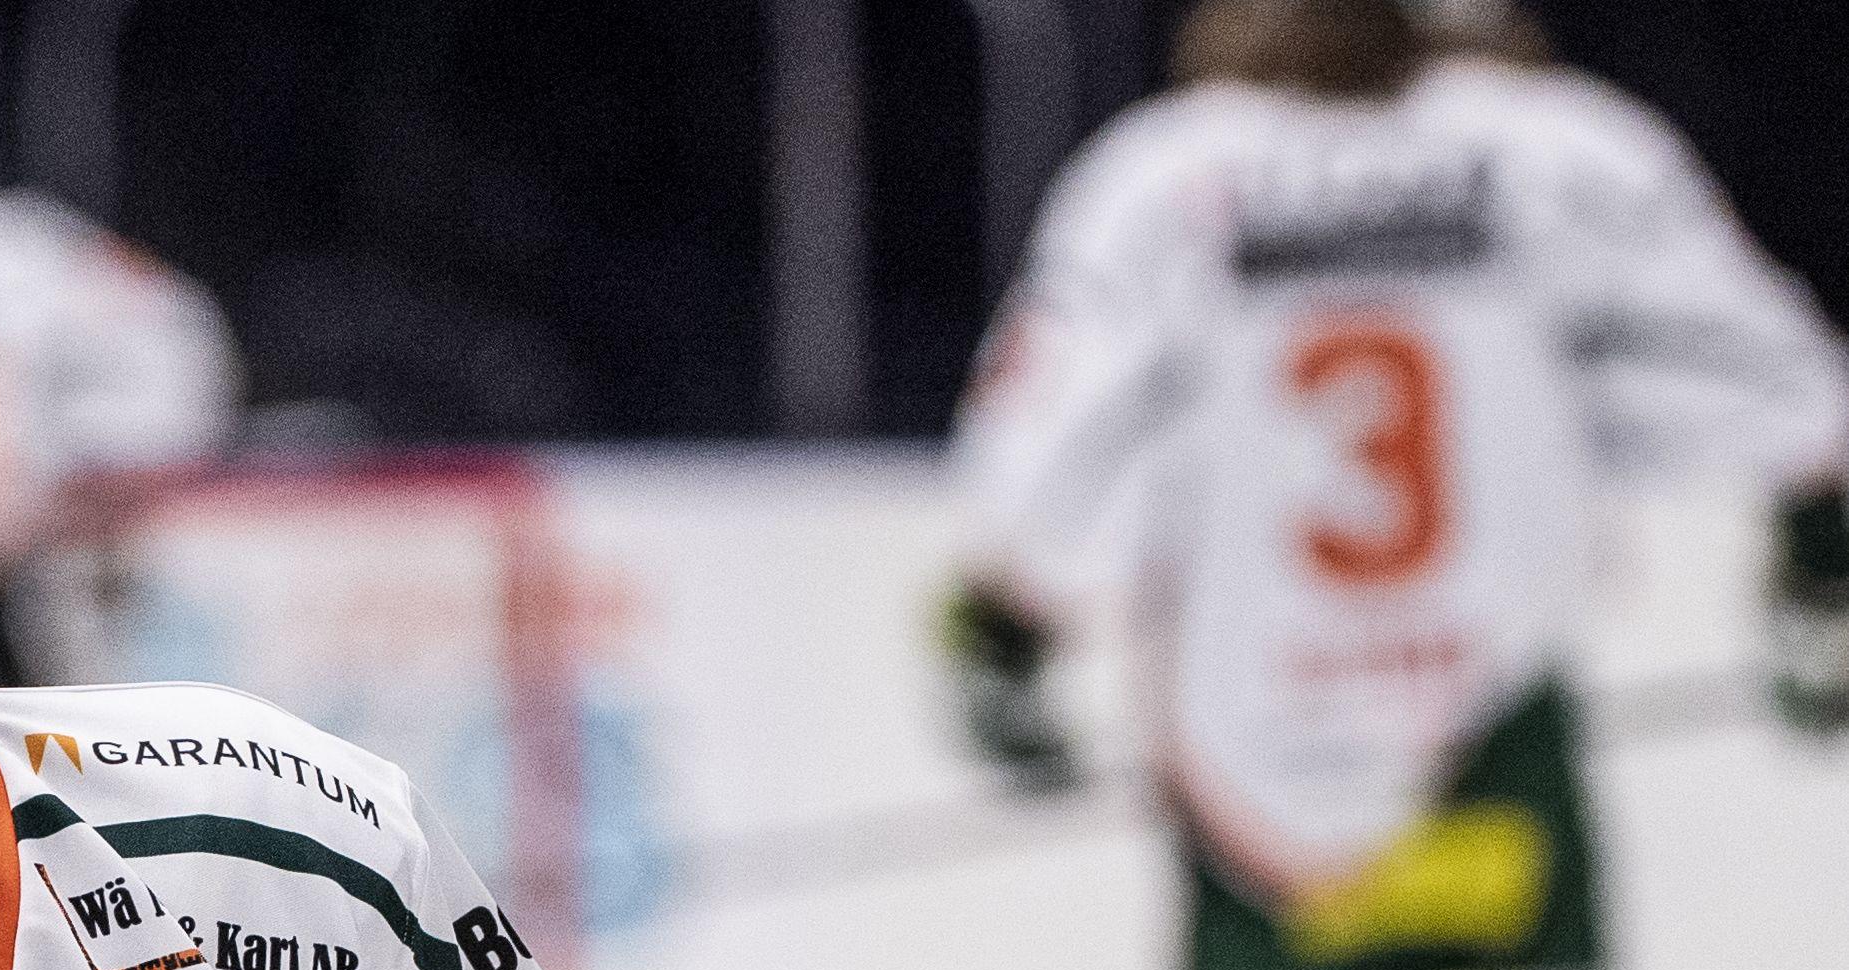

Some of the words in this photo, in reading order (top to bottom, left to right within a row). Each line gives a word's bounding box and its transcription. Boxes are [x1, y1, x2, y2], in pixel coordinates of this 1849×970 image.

[1277, 318, 1451, 594] 3
[90, 737, 382, 831] GARANTUM
[68, 877, 143, 939] Wä
